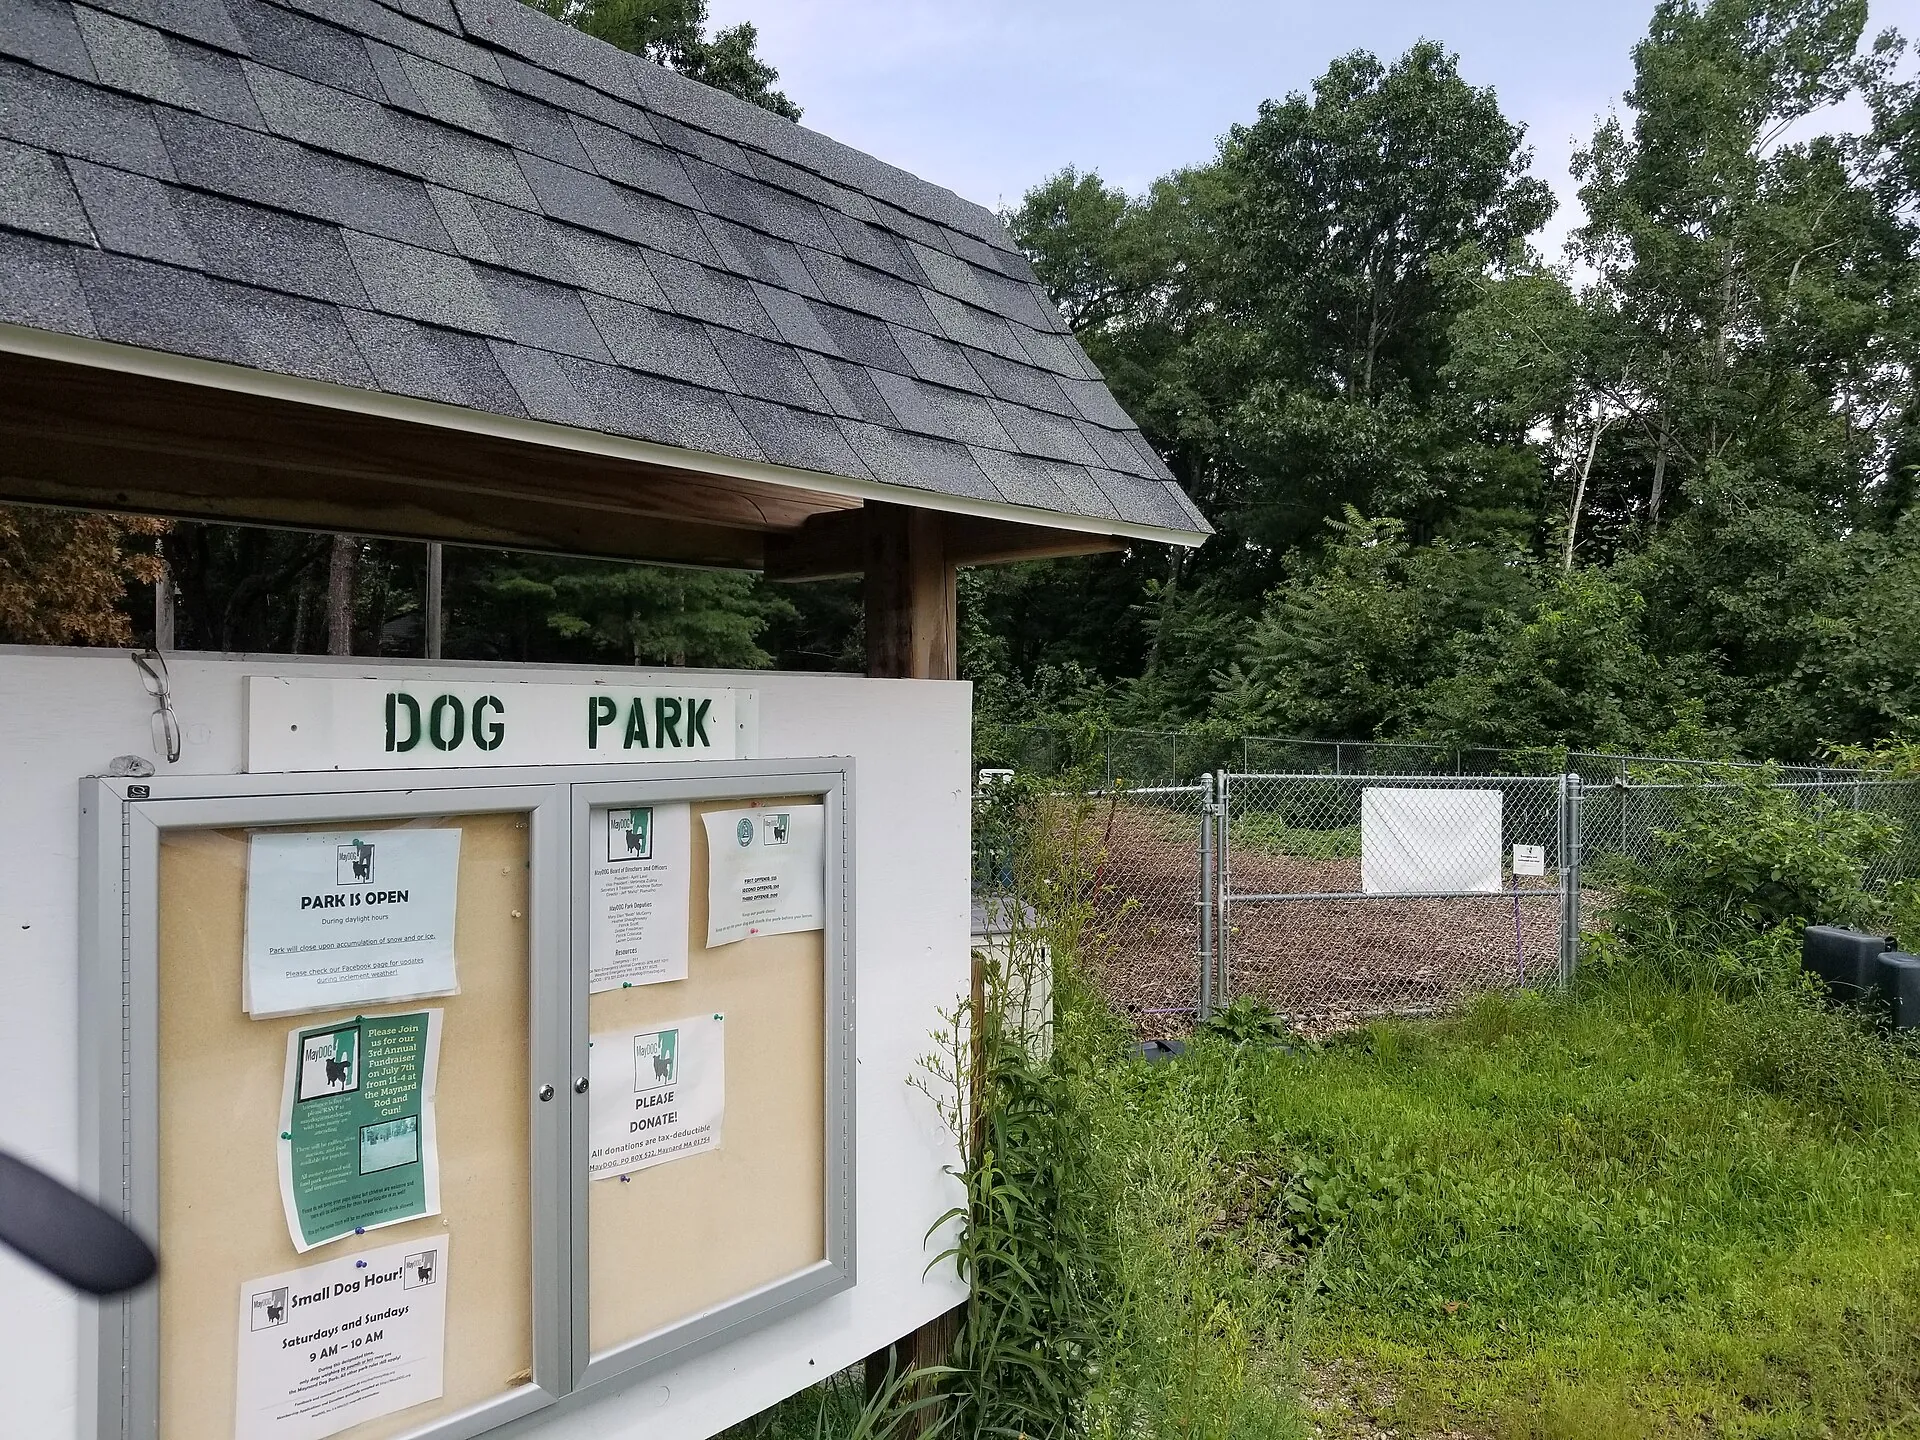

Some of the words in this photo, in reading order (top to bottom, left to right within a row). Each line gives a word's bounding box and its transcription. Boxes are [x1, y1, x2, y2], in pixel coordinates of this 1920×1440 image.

[385, 693, 505, 752] DOG
[588, 696, 713, 750] PARK
[611, 819, 630, 831] MayDOG
[339, 852, 357, 862] MayDOG
[301, 893, 346, 910] PARK
[350, 893, 361, 907] IS
[365, 890, 409, 905] OPEN
[321, 917, 344, 925] During
[345, 914, 370, 924] daylight
[269, 946, 285, 954] Park
[299, 943, 317, 951] close
[318, 942, 335, 950] upon
[336, 938, 378, 948] accumulation
[379, 936, 386, 944] of
[425, 932, 436, 940] ice.
[615, 948, 638, 956] Resources
[285, 970, 307, 978] Please
[309, 967, 328, 976] check
[342, 963, 371, 972] Facebook
[372, 961, 389, 970] page
[389, 959, 399, 967] for
[400, 957, 424, 966] updates
[317, 976, 337, 984] during
[338, 972, 369, 981] inclement
[370, 969, 398, 978] weather!
[367, 1028, 397, 1038] Please
[398, 1025, 419, 1034] Join
[383, 1037, 396, 1045] for
[398, 1035, 415, 1043] our
[305, 1045, 332, 1062] MayDOG
[368, 1048, 382, 1058] 3rd
[384, 1044, 417, 1055] Annual
[636, 1042, 658, 1059] MayDOG
[368, 1054, 416, 1068] Fundraiser
[368, 1070, 380, 1079] on
[381, 1066, 399, 1076] July
[401, 1063, 415, 1072] 7th
[366, 1079, 387, 1089] from
[388, 1074, 406, 1084] 11-4
[407, 1072, 416, 1080] at
[364, 1090, 379, 1099] the
[380, 1082, 417, 1097] Maynard
[374, 1098, 391, 1108] Rod
[392, 1094, 408, 1104] and
[635, 1091, 675, 1110] PLEASE
[381, 1106, 402, 1116] Gun!
[629, 1111, 678, 1133] DONATE!
[591, 1149, 603, 1158] All
[604, 1140, 644, 1155] donations
[645, 1137, 657, 1146] are
[658, 1124, 711, 1143] tax-deductible
[630, 1154, 643, 1162] BOX
[657, 1144, 683, 1155] Maynard
[683, 1141, 693, 1149] MA
[693, 1136, 711, 1146] 01754
[291, 1286, 330, 1308] Small
[334, 1279, 361, 1297] Dog
[364, 1266, 403, 1287] Hour!
[282, 1326, 339, 1349] Saturdays
[341, 1316, 362, 1331] and
[365, 1305, 410, 1325] Sundays
[309, 1352, 316, 1363] 9
[320, 1344, 338, 1360] AM
[351, 1338, 362, 1350] 10
[365, 1330, 383, 1346] AM
[318, 1365, 332, 1373] During
[341, 1354, 363, 1365] designated
[297, 1382, 318, 1393] Maynard
